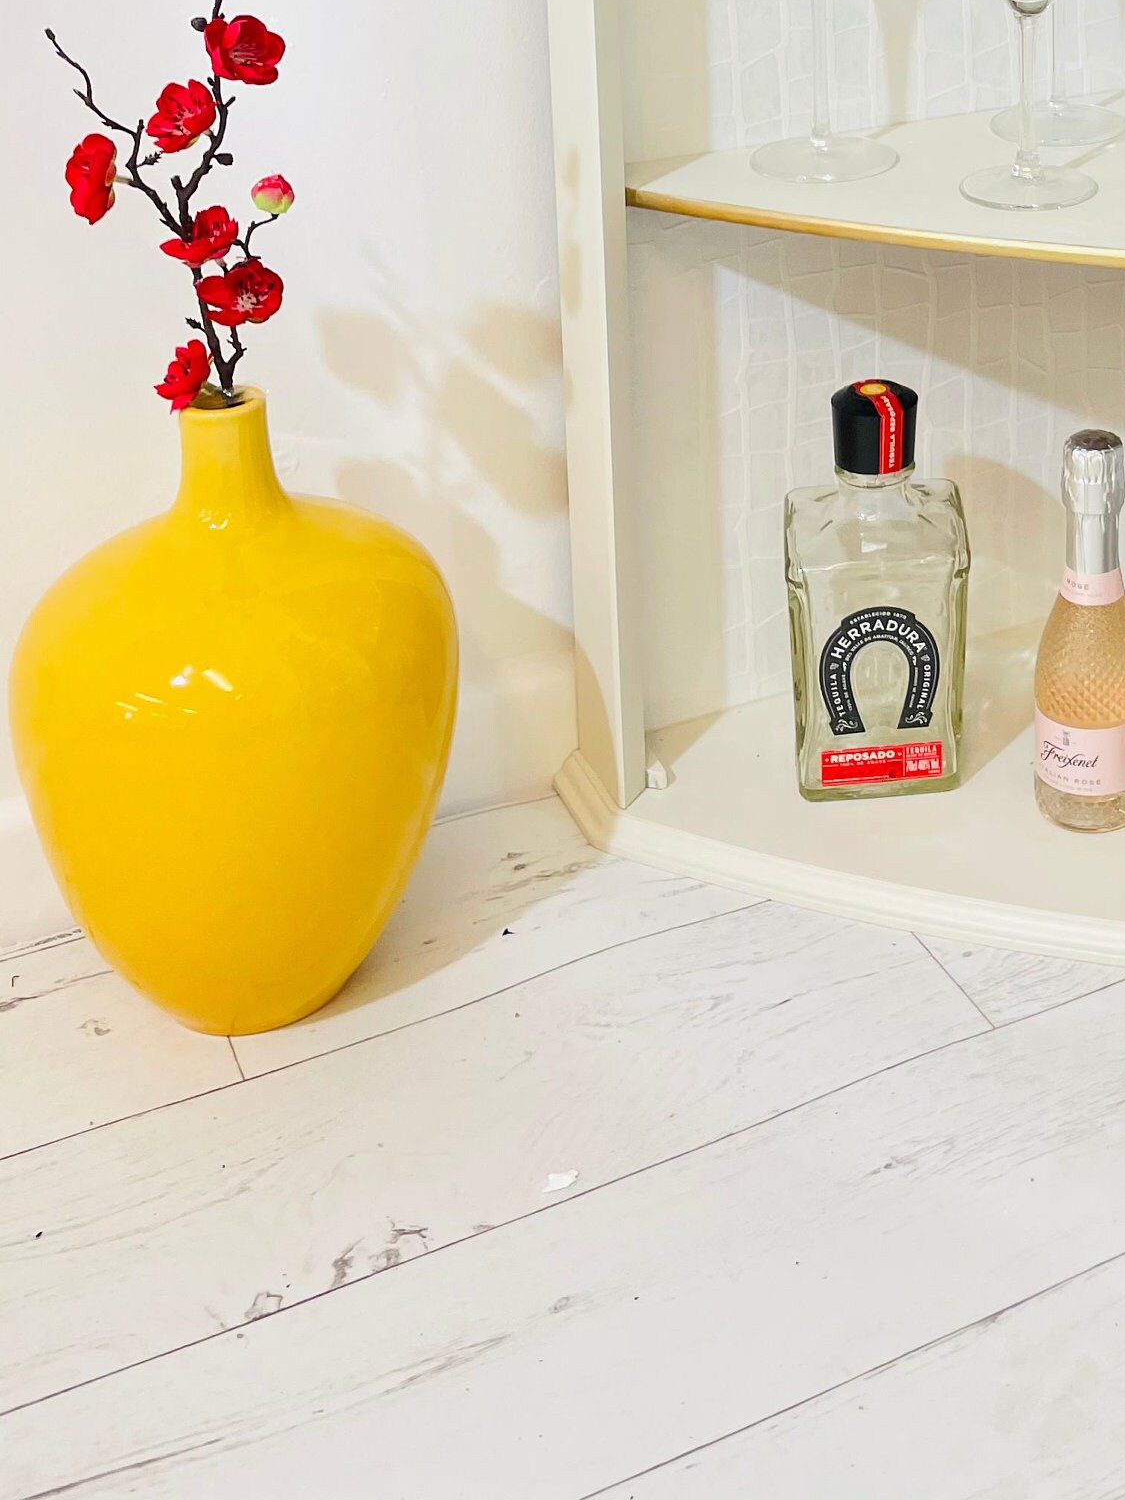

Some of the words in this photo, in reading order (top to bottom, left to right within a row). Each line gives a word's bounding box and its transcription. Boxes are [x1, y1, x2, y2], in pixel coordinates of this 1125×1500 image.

[830, 619, 927, 660] HERRADURA
[830, 673, 847, 717] TEQUILA
[916, 664, 932, 710] ORIGINAL
[830, 749, 896, 763] REPOSADO
[905, 745, 937, 755] TEQUILA
[1040, 740, 1099, 769] Freixenet
